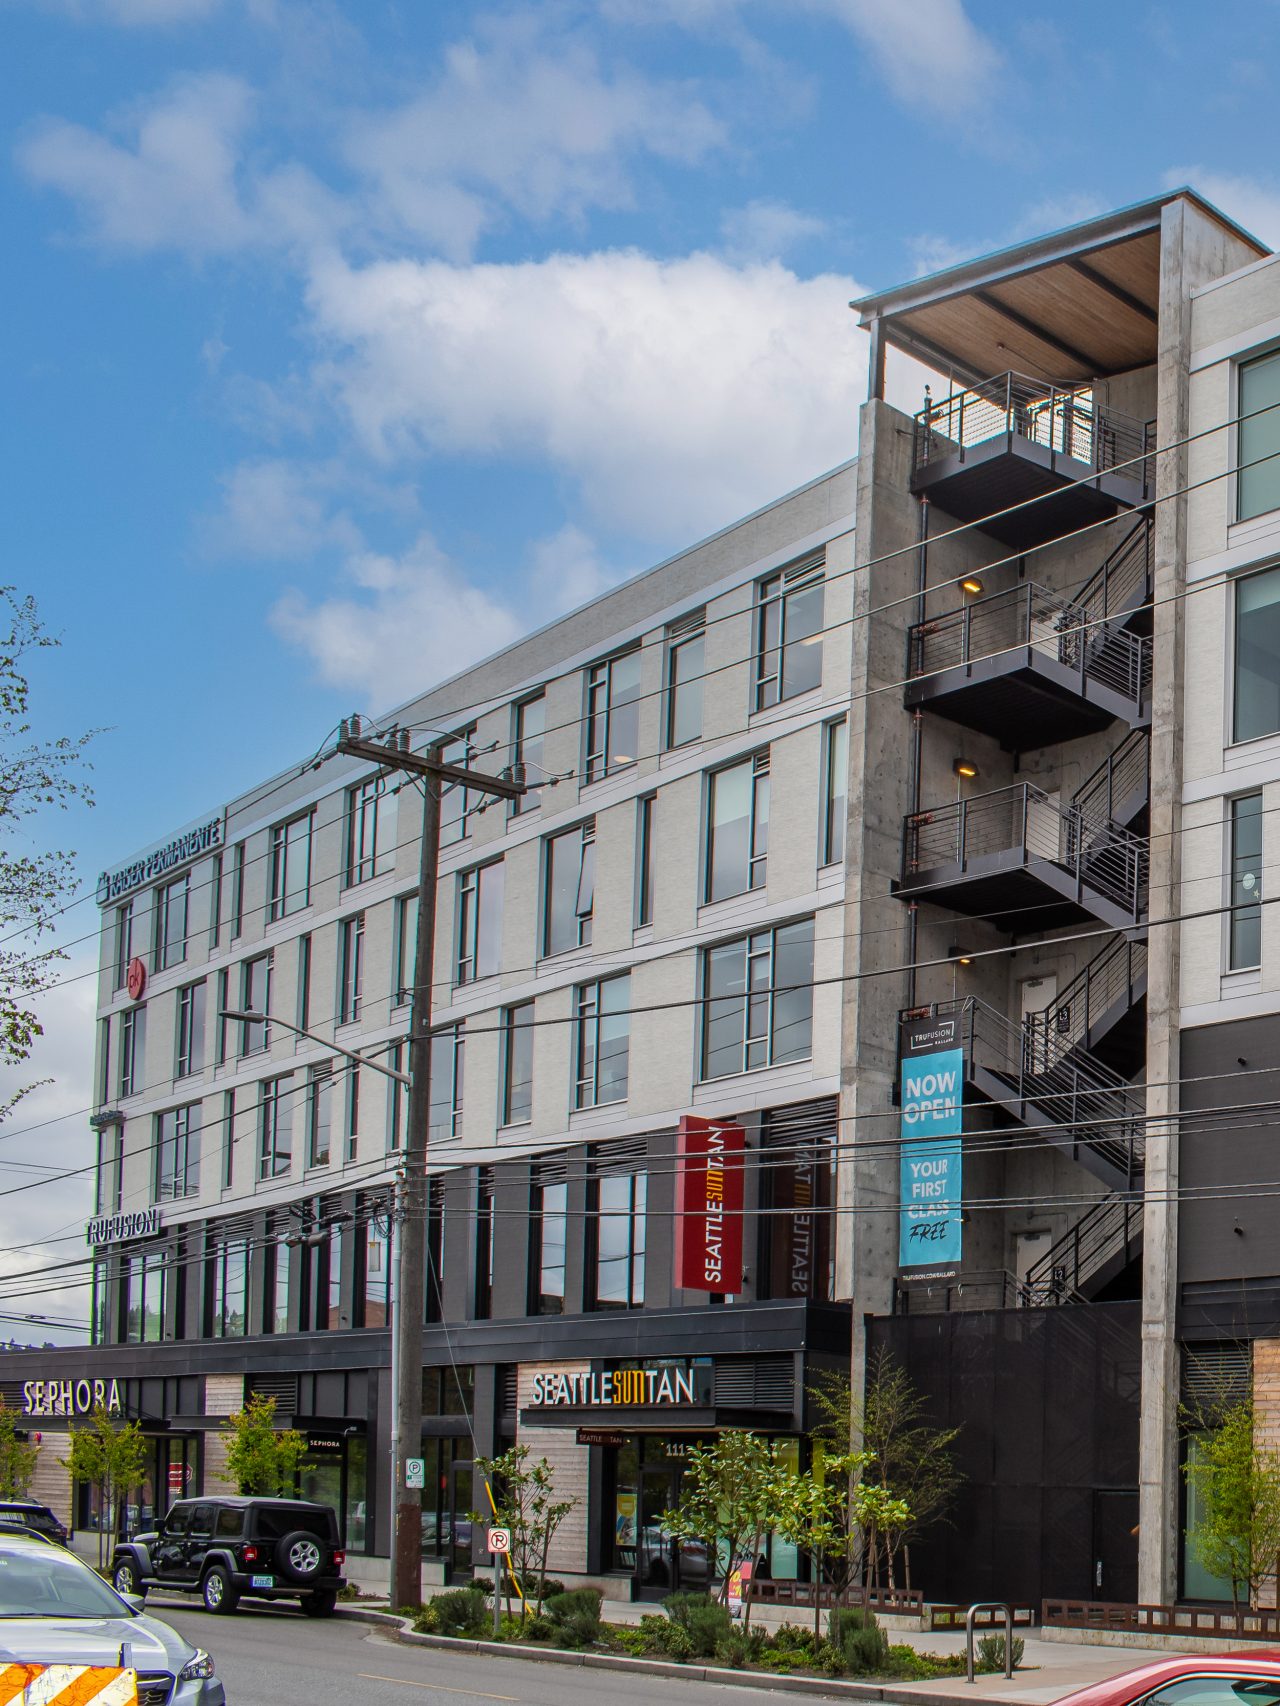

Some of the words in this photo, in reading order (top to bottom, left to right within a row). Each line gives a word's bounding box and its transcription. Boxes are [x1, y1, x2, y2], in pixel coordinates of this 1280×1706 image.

[111, 859, 145, 897] KAISER
[914, 1029, 951, 1043] TRUFUSION
[906, 1071, 956, 1099] NOW
[904, 1096, 956, 1123] OPEN
[910, 1159, 948, 1178] YOUR
[912, 1180, 947, 1198] FIRST
[908, 1200, 950, 1219] CLASS
[909, 1220, 950, 1243] FREE
[23, 1378, 121, 1413] SEPHORA
[310, 1439, 340, 1448] SEPHORA
